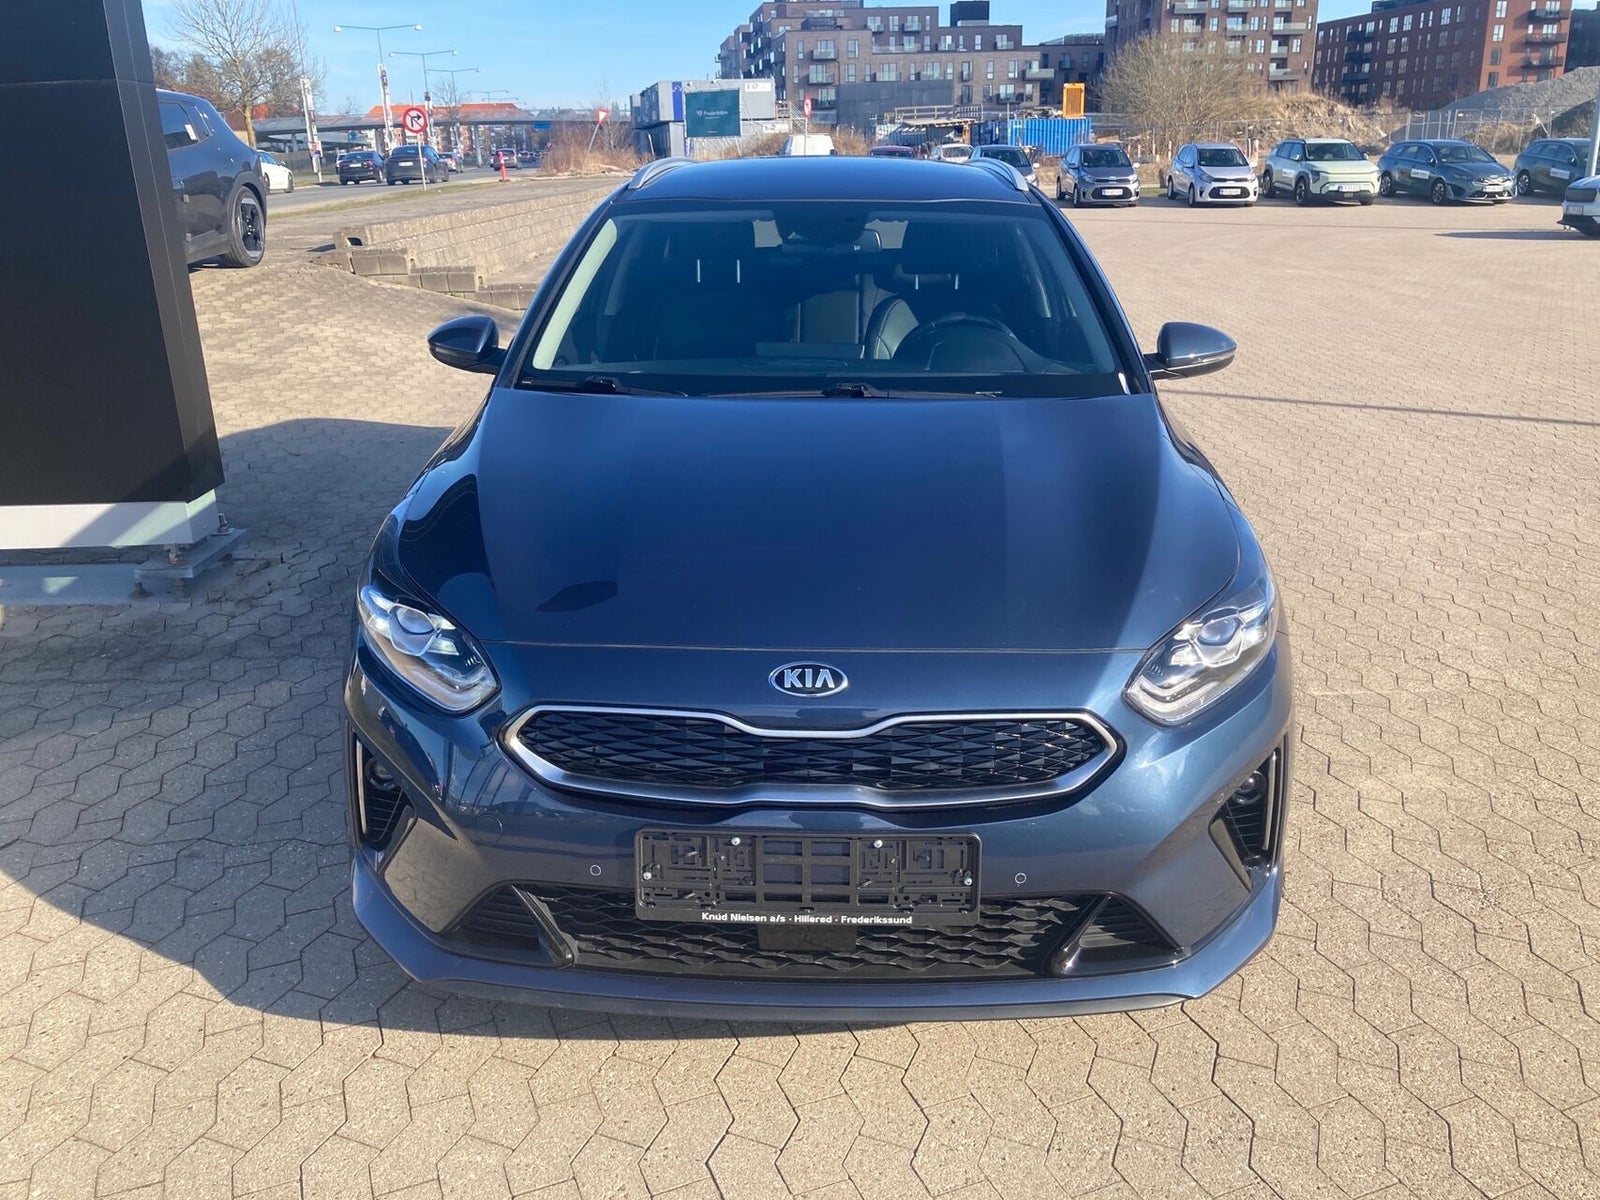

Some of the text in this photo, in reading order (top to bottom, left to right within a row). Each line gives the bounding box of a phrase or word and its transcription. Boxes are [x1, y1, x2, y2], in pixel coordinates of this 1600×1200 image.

[784, 668, 835, 688] KIA
[701, 912, 913, 924] Knud Nielsen a/s Hillerød Frederikssund
